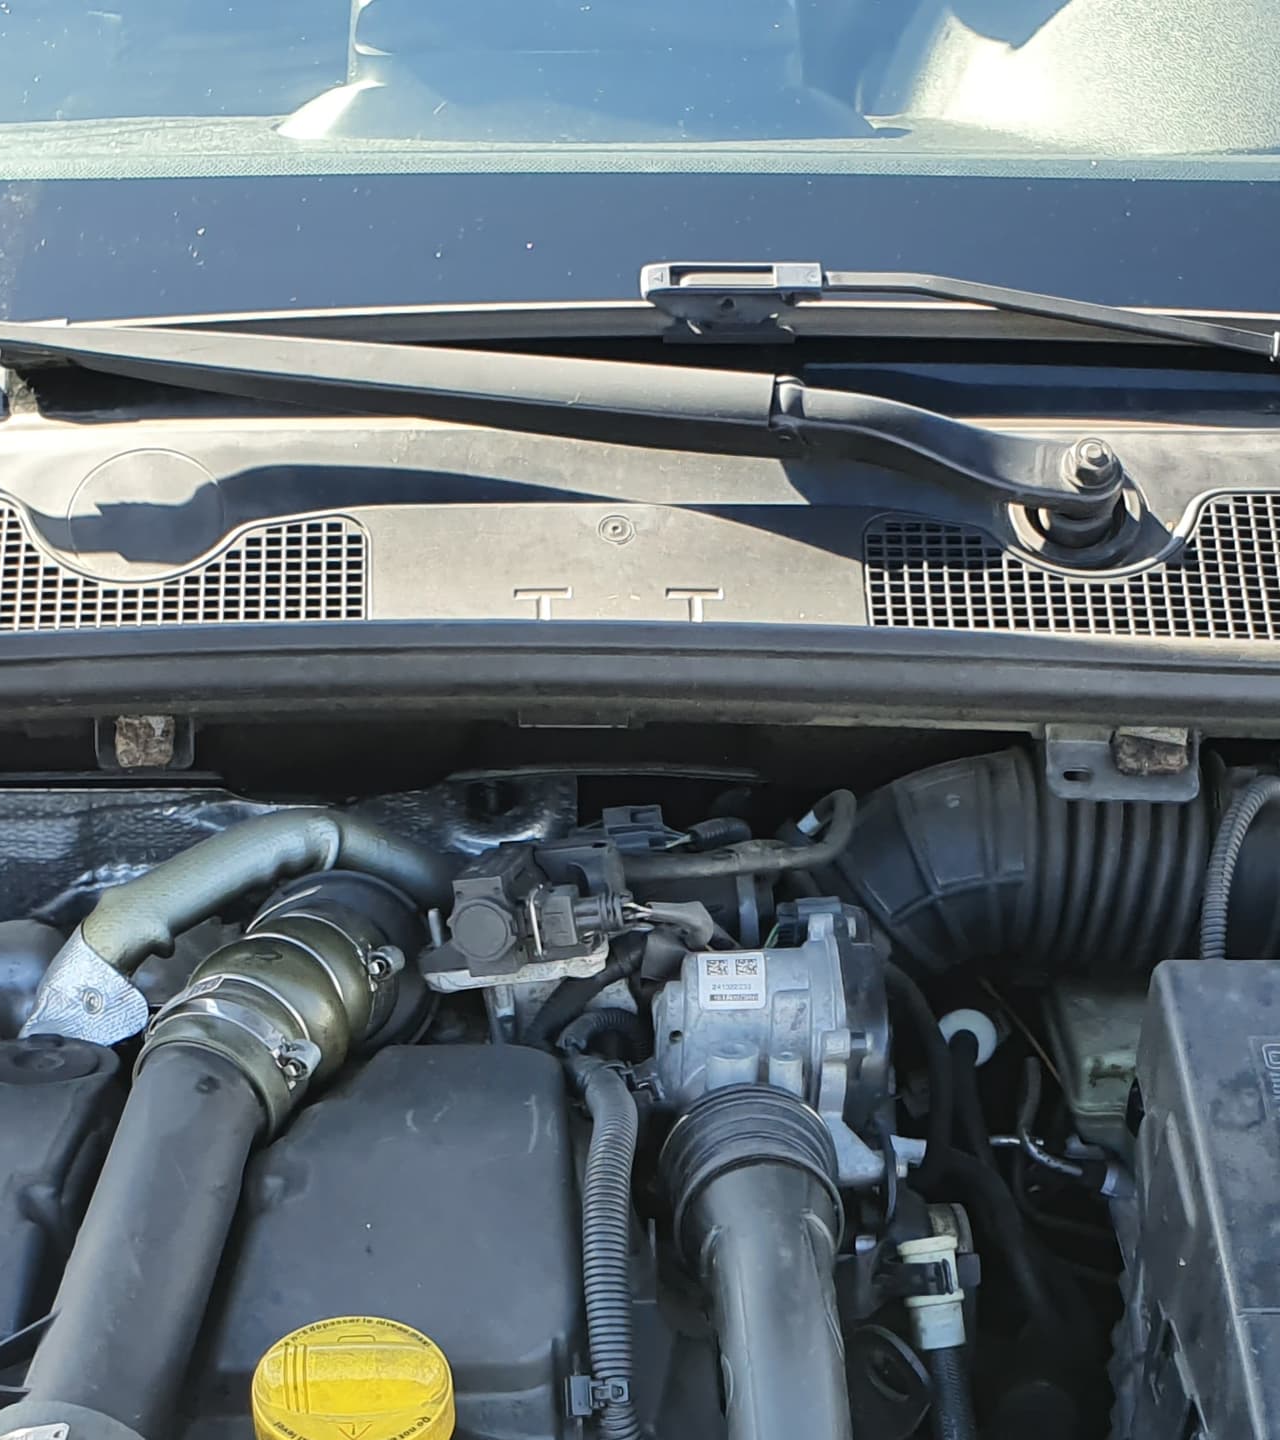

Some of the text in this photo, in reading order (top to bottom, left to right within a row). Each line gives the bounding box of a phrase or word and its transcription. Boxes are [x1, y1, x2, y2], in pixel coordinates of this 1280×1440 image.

[416, 1416, 432, 1428] Do
[272, 1421, 297, 1438] level
[399, 1425, 417, 1439] not
